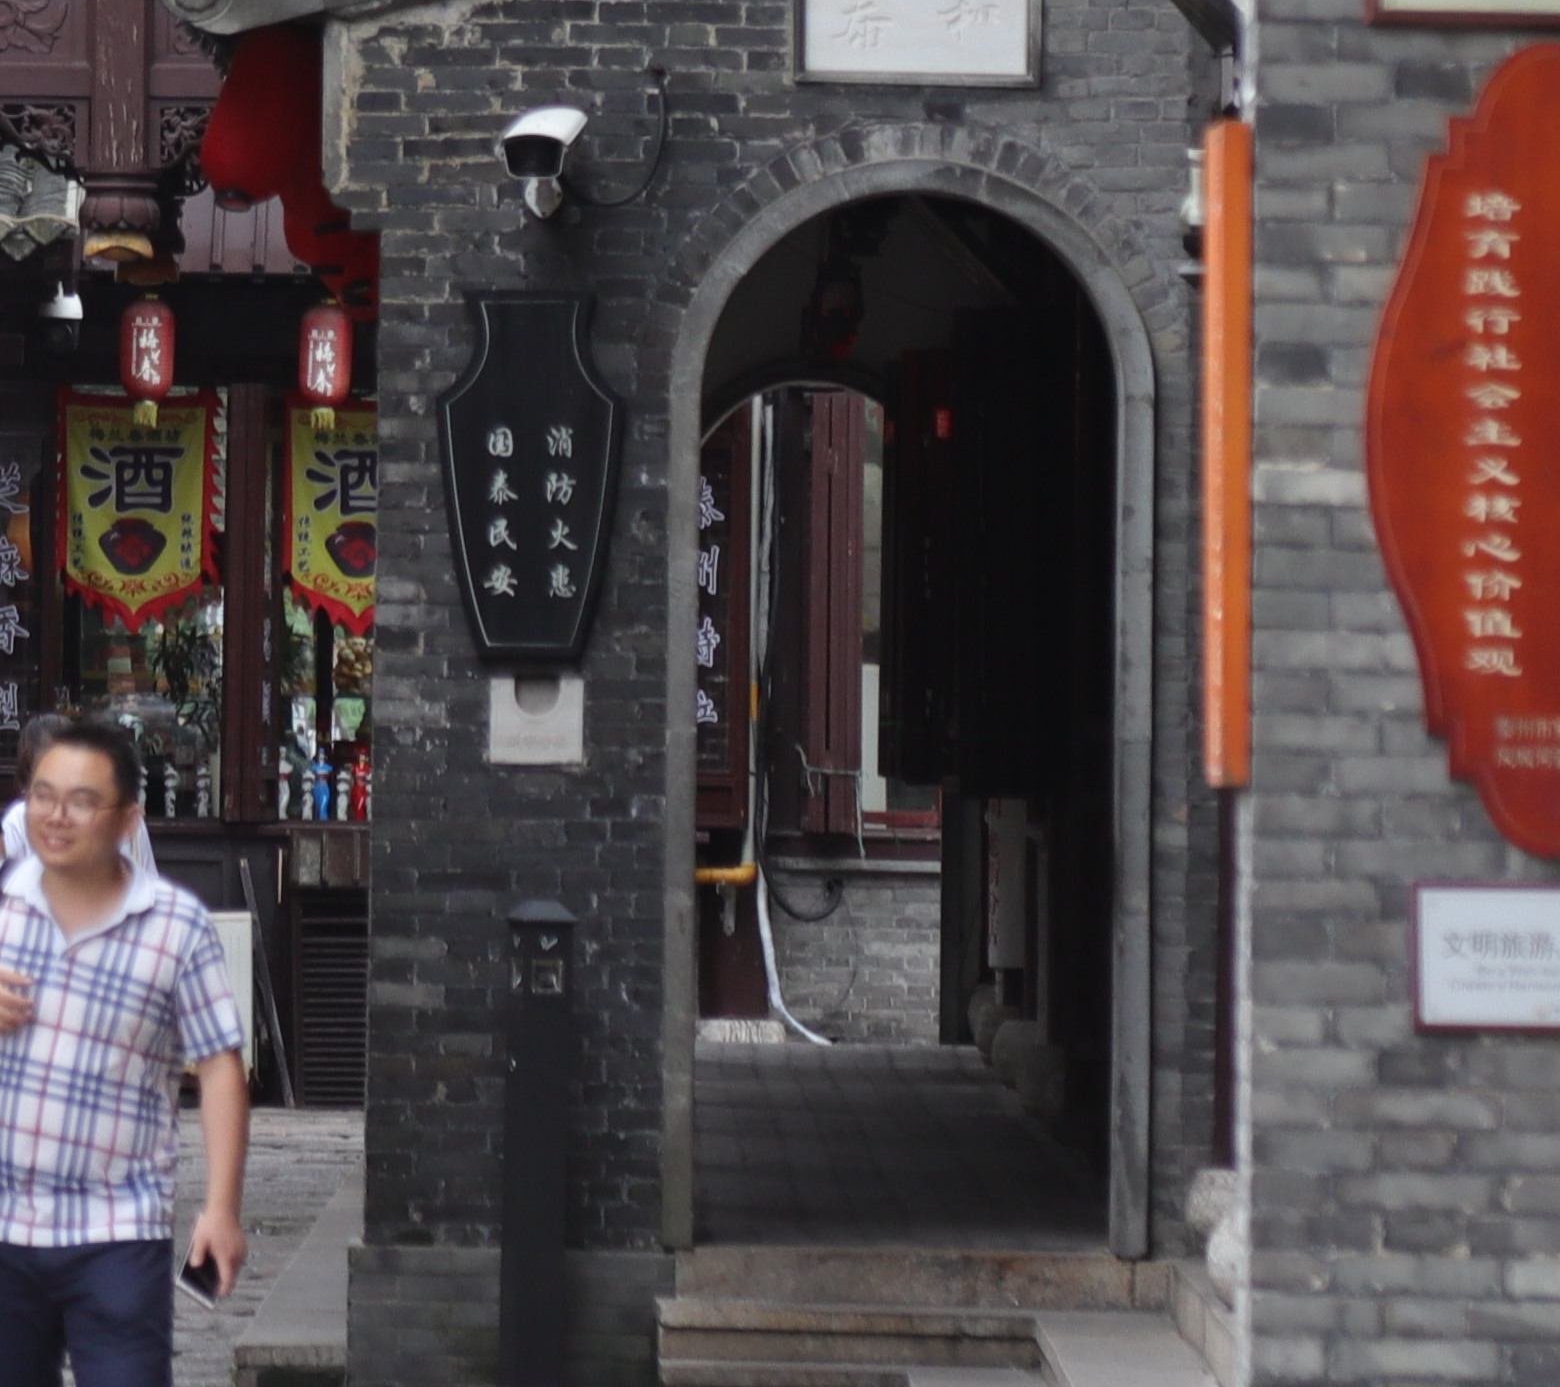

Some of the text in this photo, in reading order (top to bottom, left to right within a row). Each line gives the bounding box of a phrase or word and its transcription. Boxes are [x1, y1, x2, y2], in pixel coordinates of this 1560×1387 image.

[79, 445, 186, 515] 酒
[305, 448, 378, 517] 酒
[484, 425, 519, 598] 国泰民安
[546, 425, 578, 598] 消防火患
[1464, 190, 1522, 677] 培育践行社会主义核心价值观
